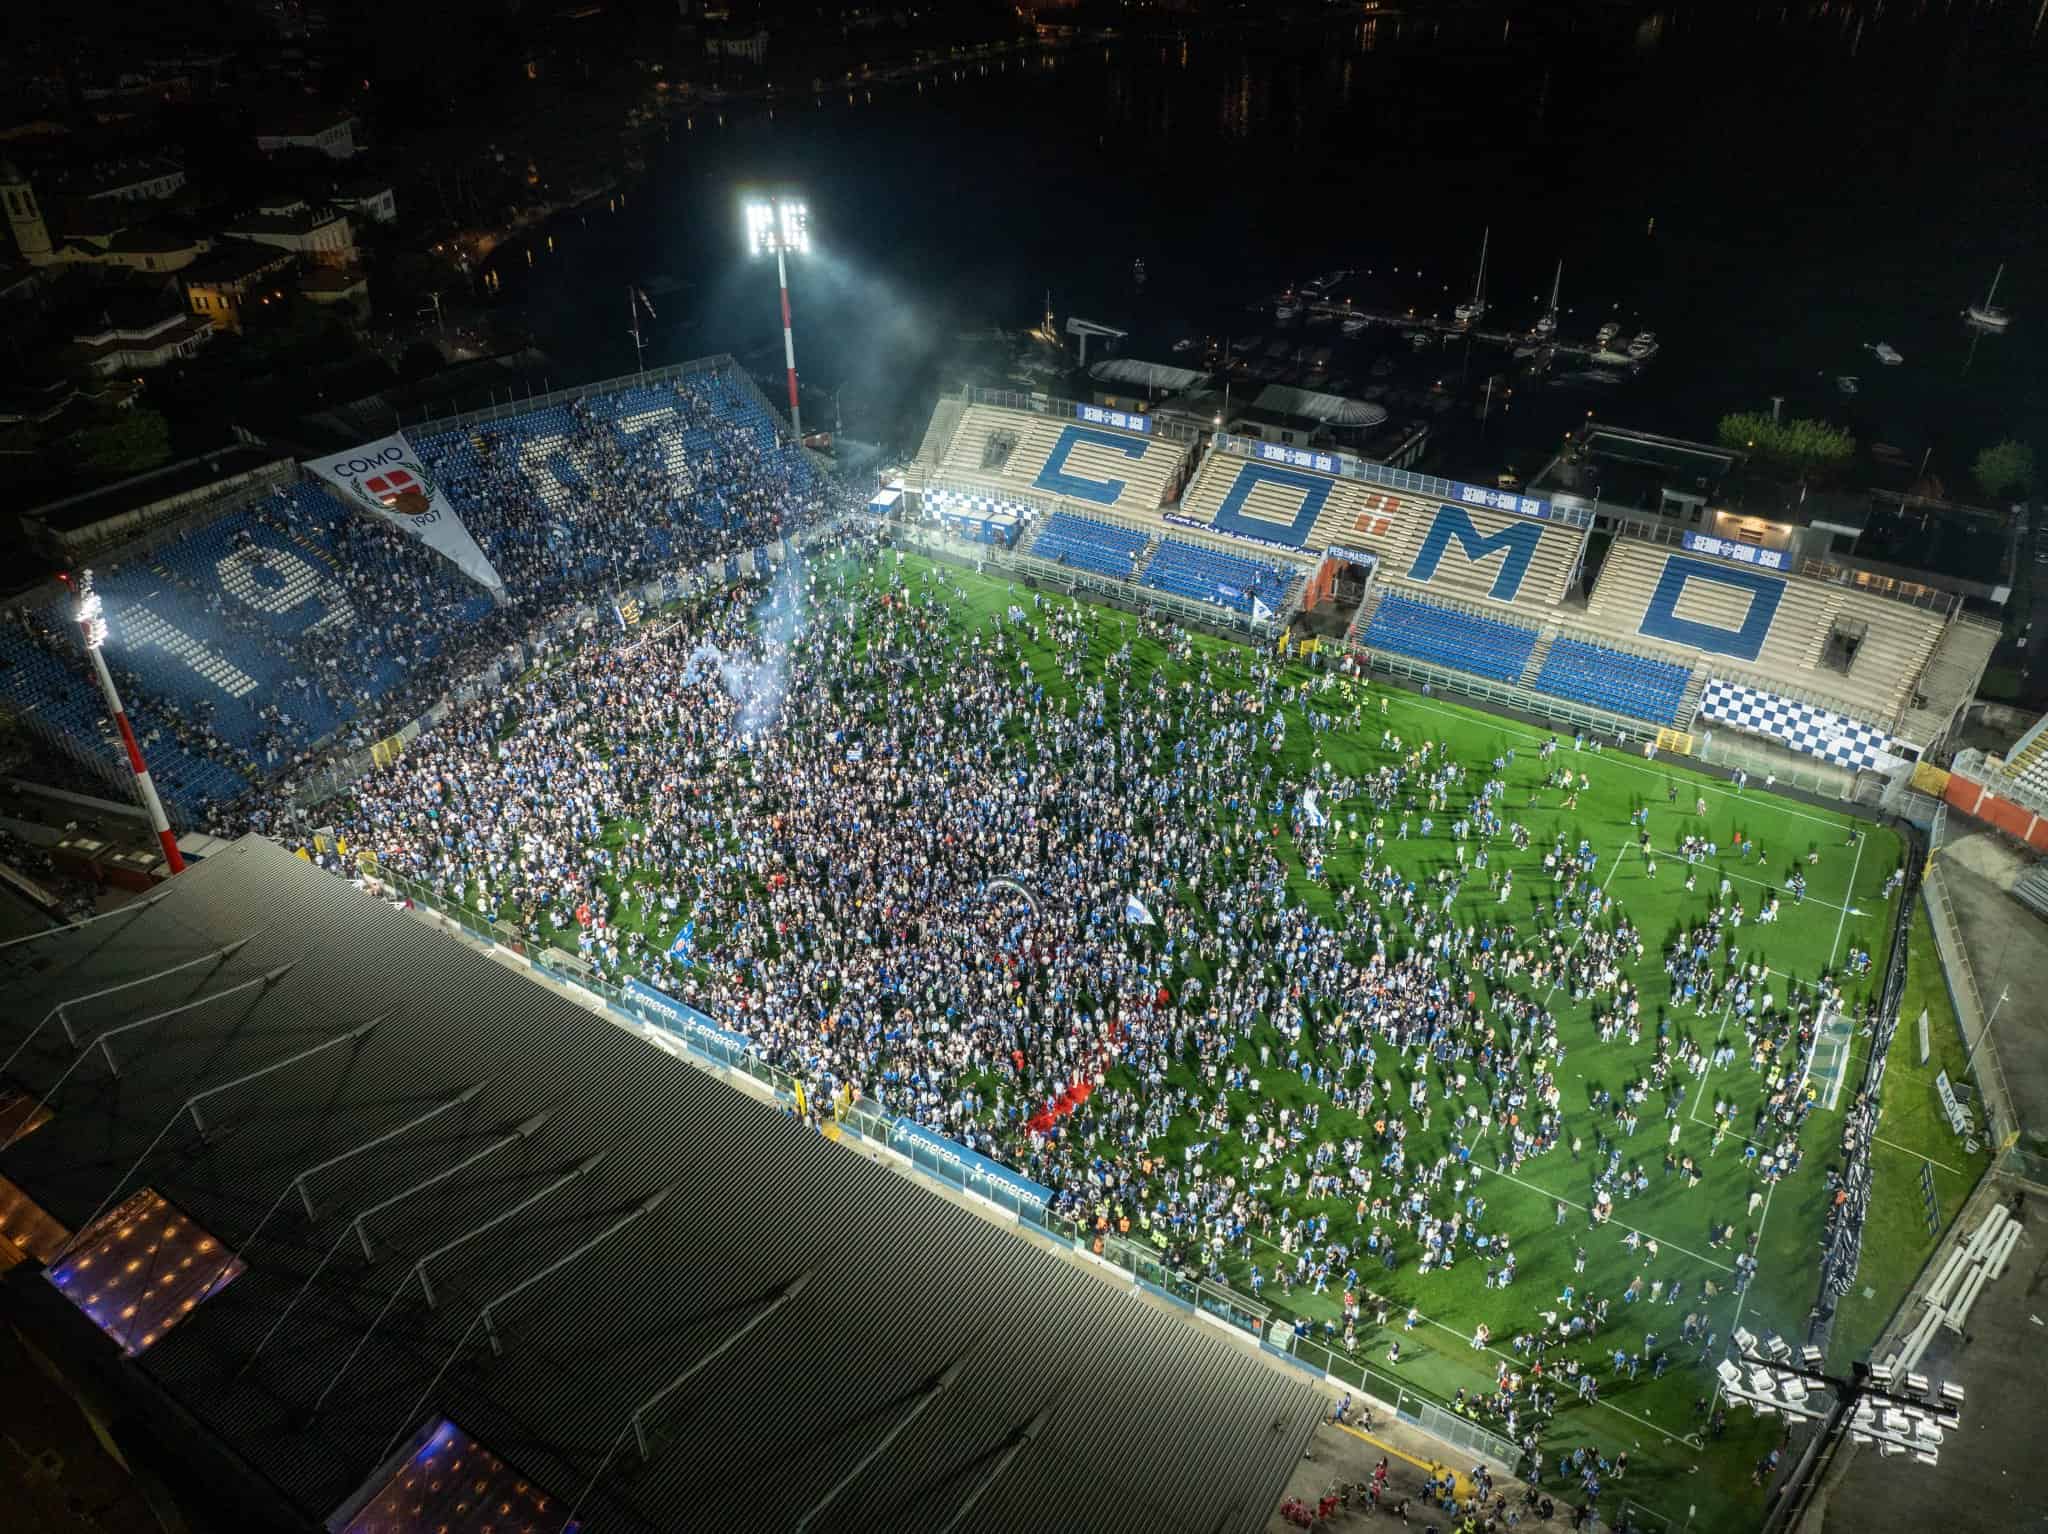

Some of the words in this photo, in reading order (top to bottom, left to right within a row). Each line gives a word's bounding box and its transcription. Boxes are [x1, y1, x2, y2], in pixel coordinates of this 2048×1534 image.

[334, 447, 403, 477] COMO
[411, 509, 441, 528] 1907
[1031, 424, 1790, 662] COMO
[910, 1133, 961, 1166] emeren
[986, 1172, 1041, 1208] emeren
